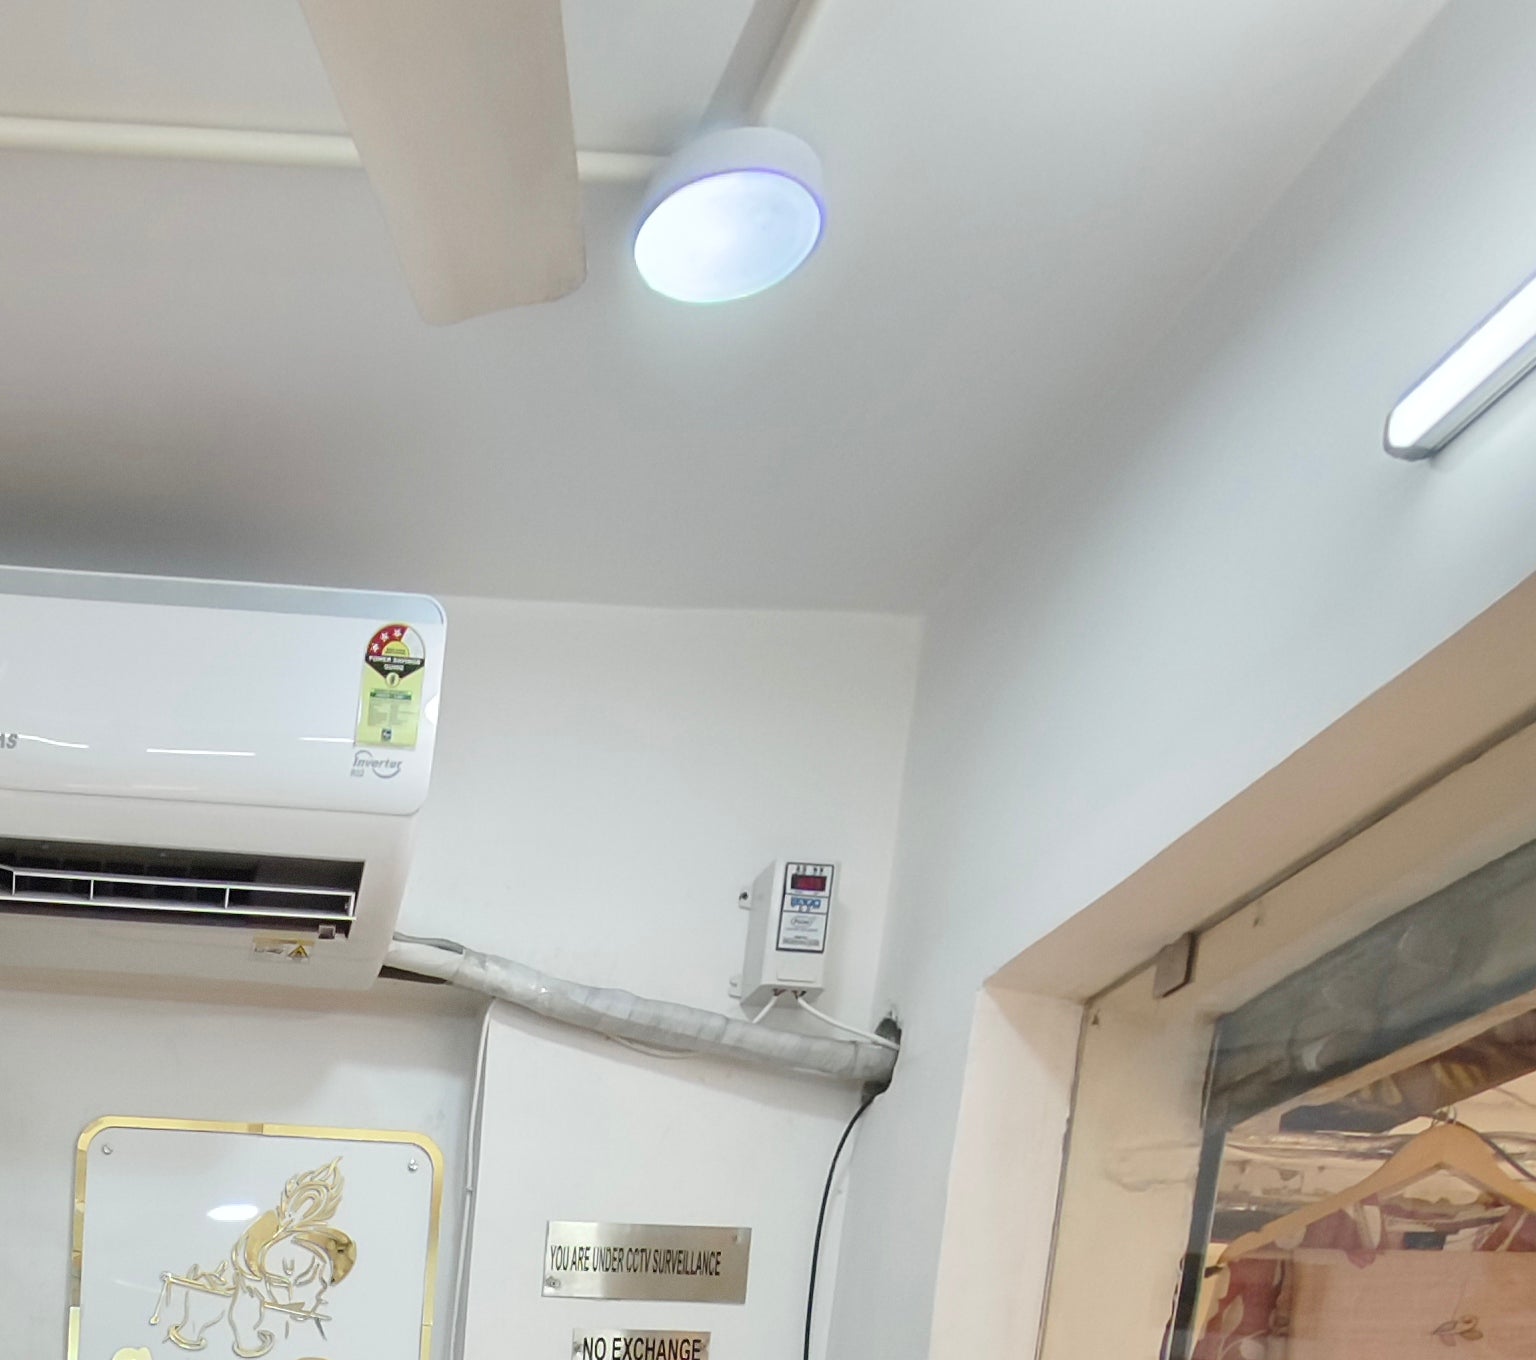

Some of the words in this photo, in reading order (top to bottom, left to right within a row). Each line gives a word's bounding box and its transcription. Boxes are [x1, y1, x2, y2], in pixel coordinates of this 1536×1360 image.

[353, 757, 403, 769] Inverter
[550, 1245, 569, 1272] YOU
[570, 1246, 591, 1272] ARE
[592, 1246, 624, 1273] UNDER
[626, 1247, 652, 1274] CCTV
[653, 1249, 722, 1277] SURVEILLANCE
[582, 1337, 607, 1360] NO
